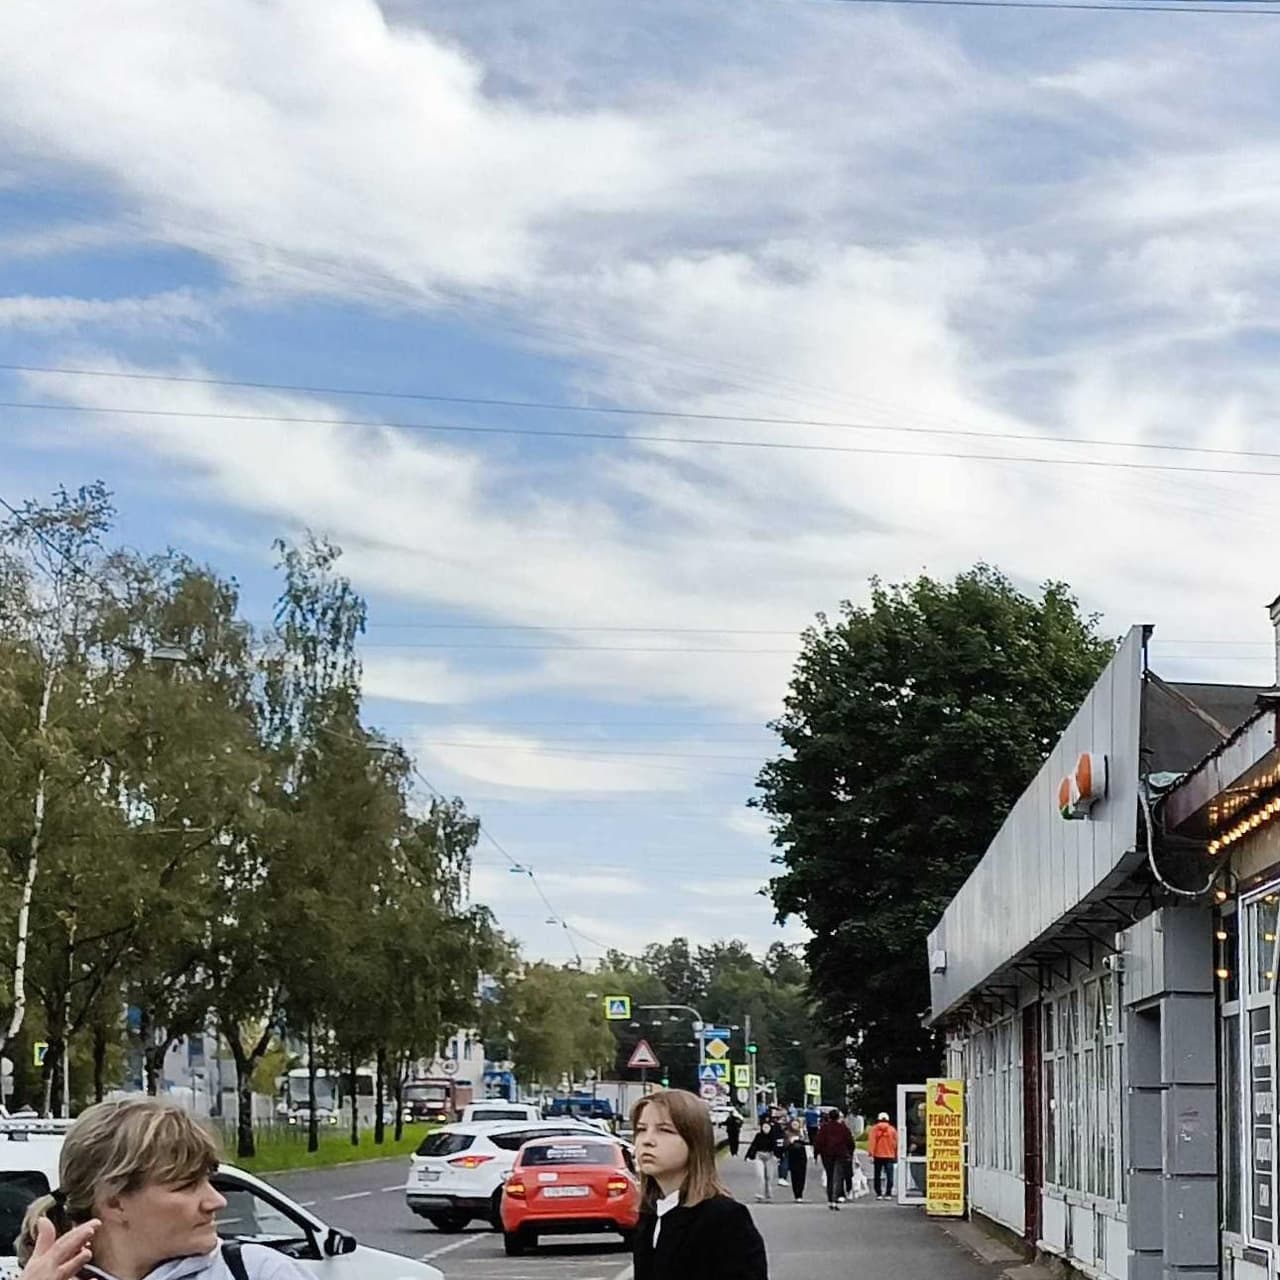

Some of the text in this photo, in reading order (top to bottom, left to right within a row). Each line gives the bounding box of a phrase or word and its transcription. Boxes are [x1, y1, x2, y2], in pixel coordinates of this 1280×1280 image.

[928, 1114, 961, 1127] РЕМОНТ
[930, 1128, 960, 1138] ОБУВИ
[928, 1160, 960, 1172] КЛЮЧИ
